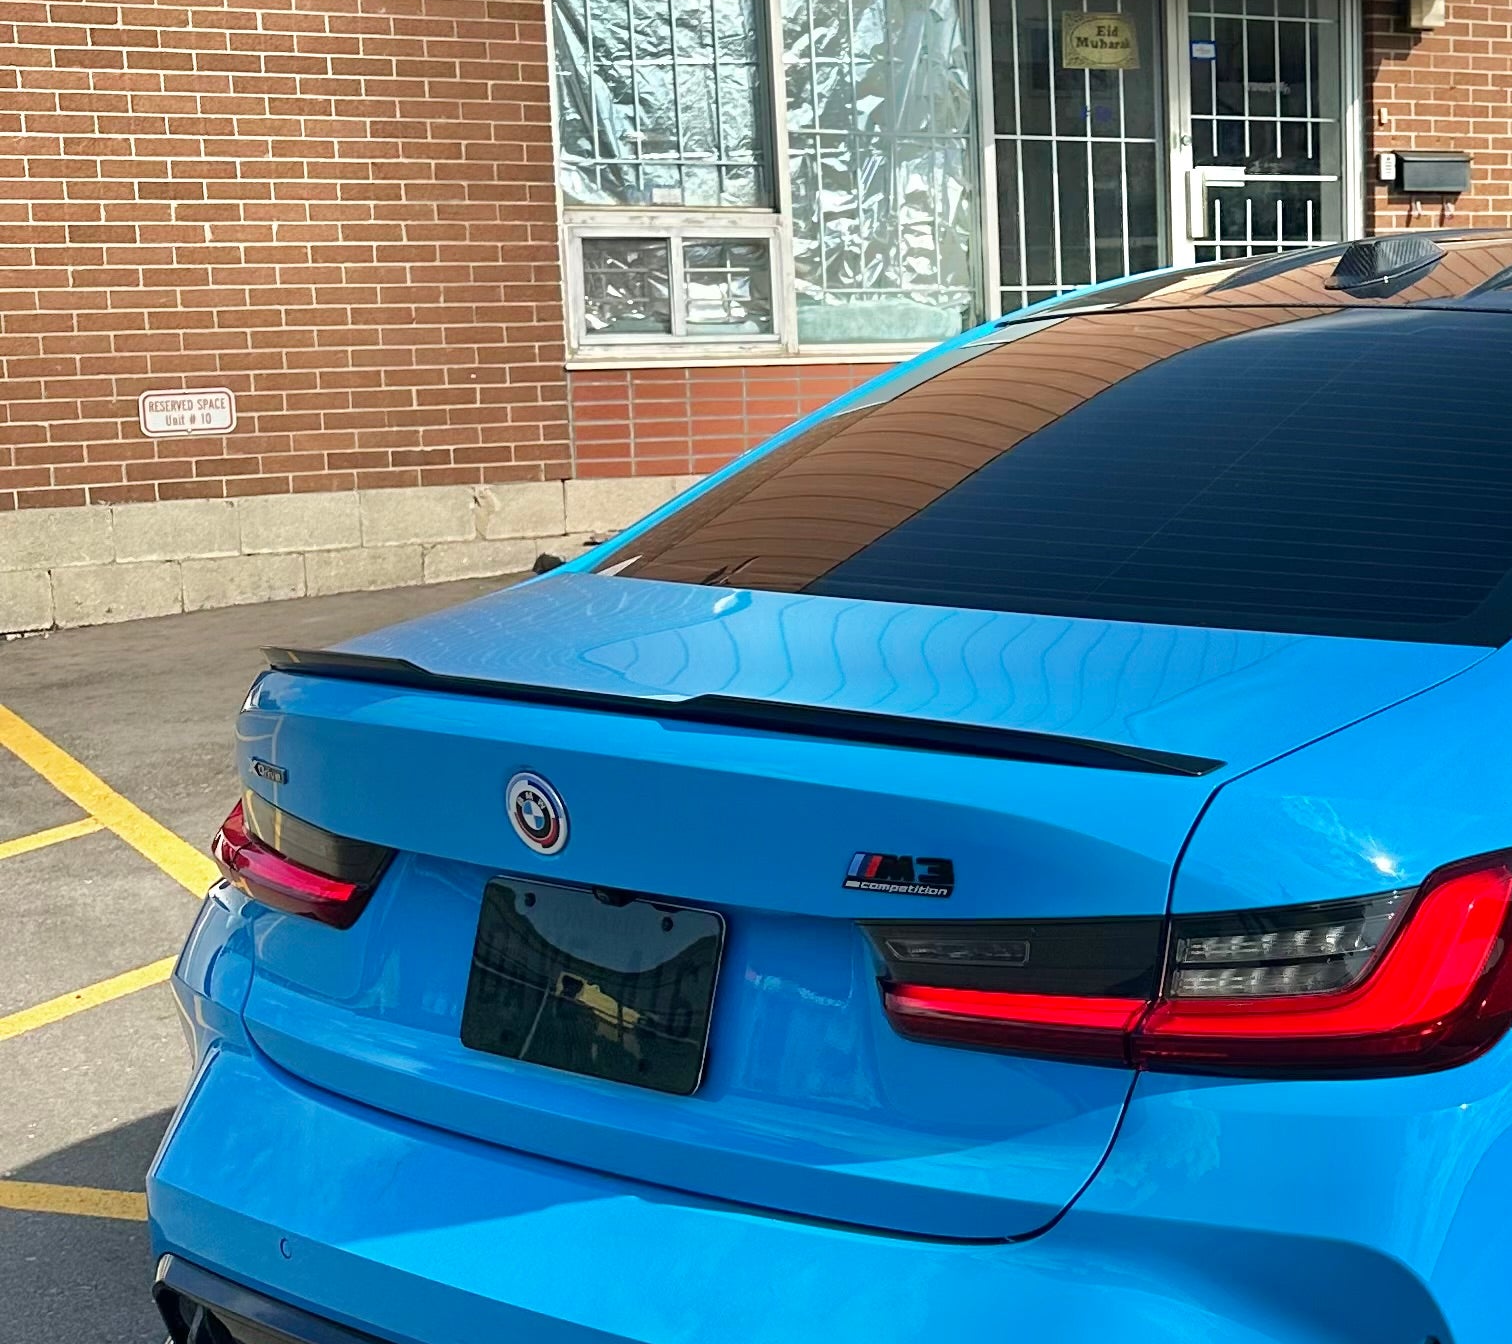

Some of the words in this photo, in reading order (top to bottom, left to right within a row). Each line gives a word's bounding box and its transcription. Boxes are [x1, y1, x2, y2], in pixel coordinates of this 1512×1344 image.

[1096, 25, 1118, 37] Eid
[148, 399, 194, 413] RESERVED
[196, 397, 227, 411] SPACE
[165, 414, 185, 427] Unit
[201, 412, 212, 425] 10
[868, 854, 954, 884] M3
[860, 881, 949, 896] competition
